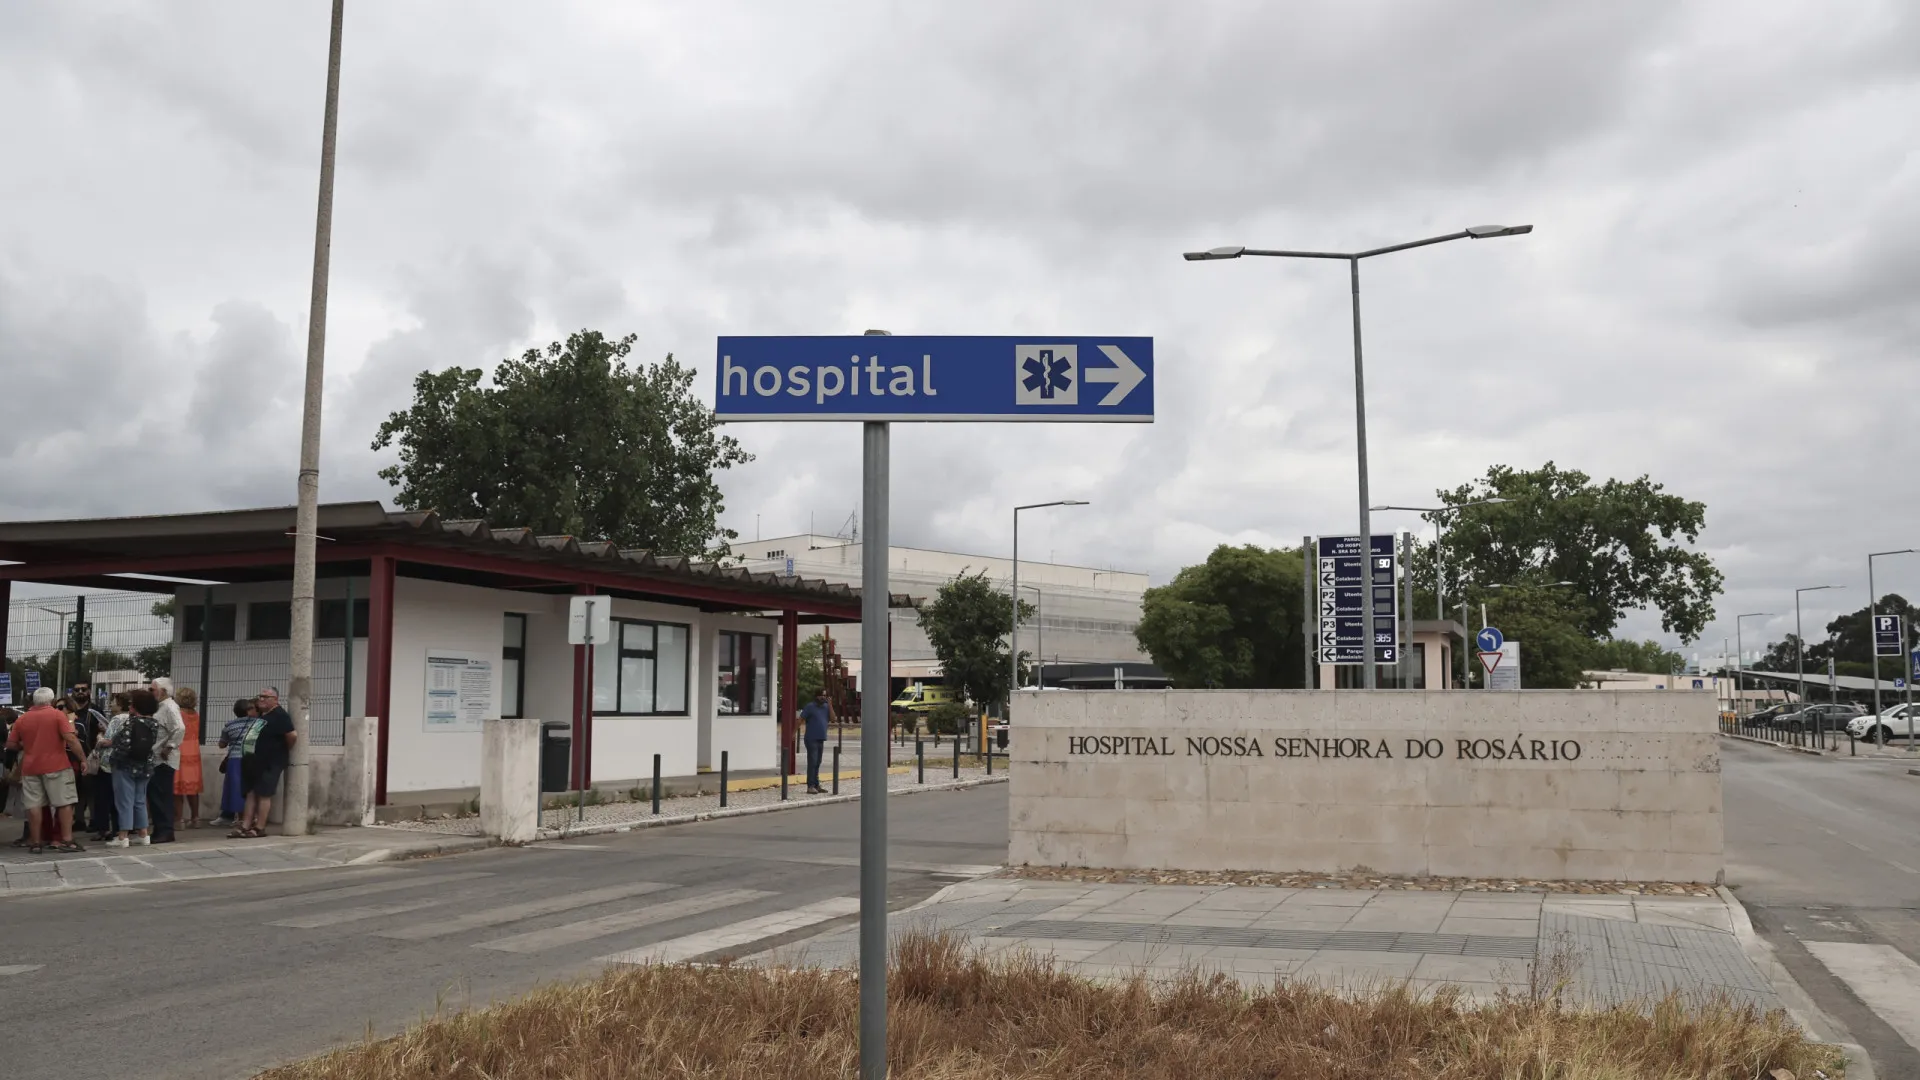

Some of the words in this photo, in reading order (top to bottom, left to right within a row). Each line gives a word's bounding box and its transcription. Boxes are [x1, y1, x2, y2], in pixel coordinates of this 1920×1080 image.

[722, 354, 938, 405] hospital
[1322, 561, 1334, 569] P1
[1379, 558, 1391, 569] 90
[1322, 591, 1335, 599] P2
[1323, 620, 1336, 628] P3
[1383, 649, 1393, 659] 12
[1895, 679, 1903, 687] P
[1068, 735, 1175, 756] HOSPITAL
[1185, 736, 1264, 757] NOSSA
[1274, 737, 1393, 758] SENHORA
[1405, 738, 1444, 759] DO
[1456, 733, 1582, 761] ROSÁRIO
